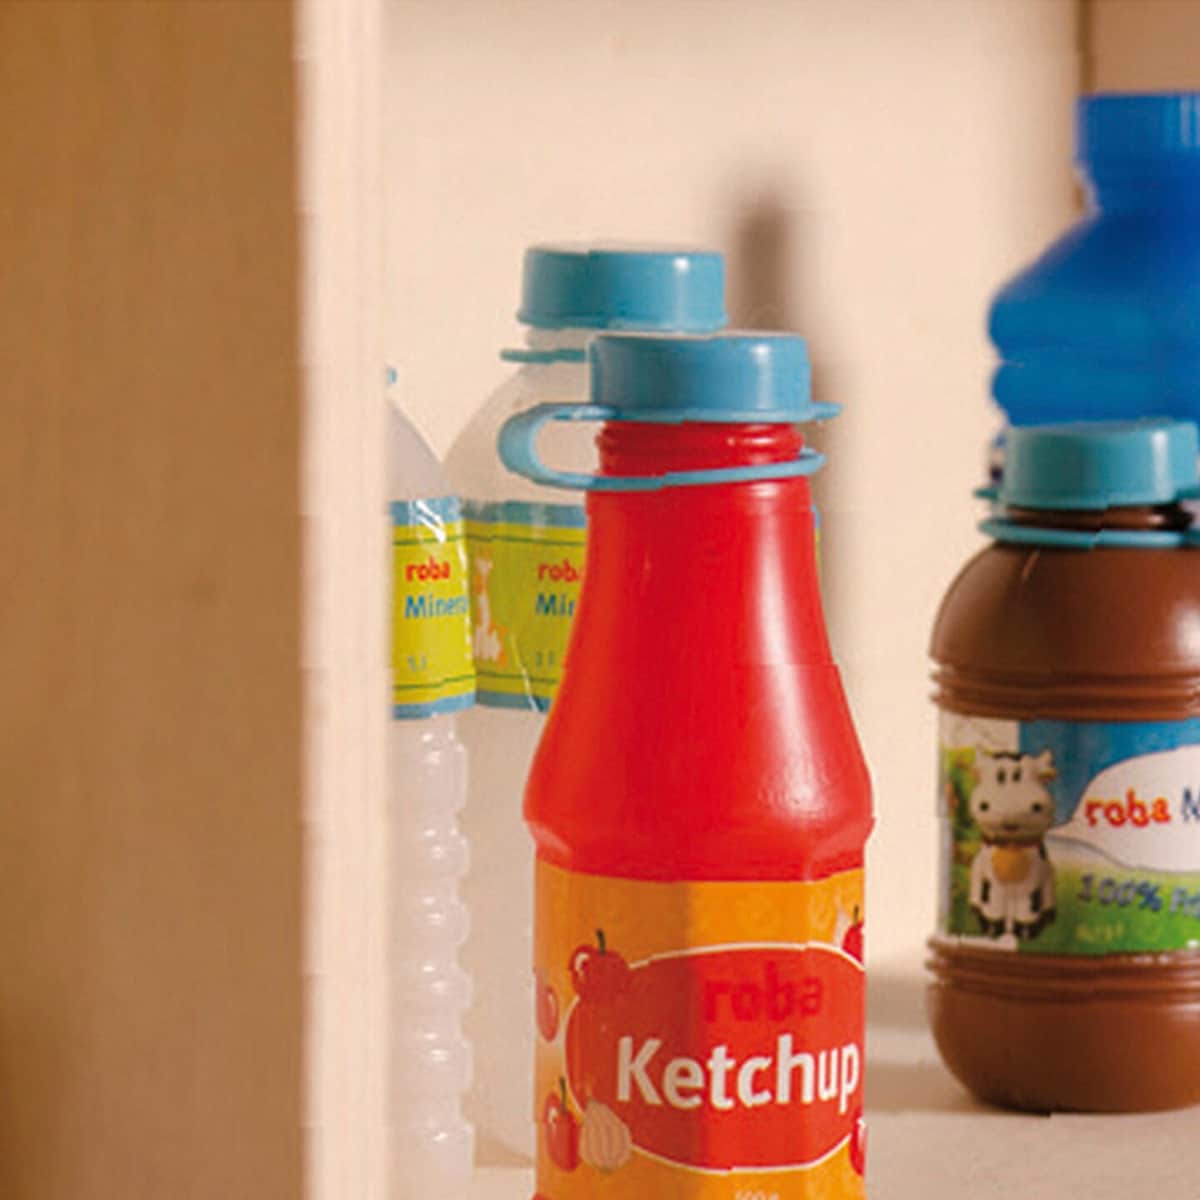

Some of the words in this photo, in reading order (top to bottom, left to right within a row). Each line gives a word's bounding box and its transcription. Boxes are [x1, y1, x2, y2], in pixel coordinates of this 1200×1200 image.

[537, 557, 584, 583] rob
[1085, 788, 1171, 828] roba
[1076, 873, 1162, 912] 100%
[704, 960, 823, 1024] roba
[616, 1033, 860, 1115] Ketchup
